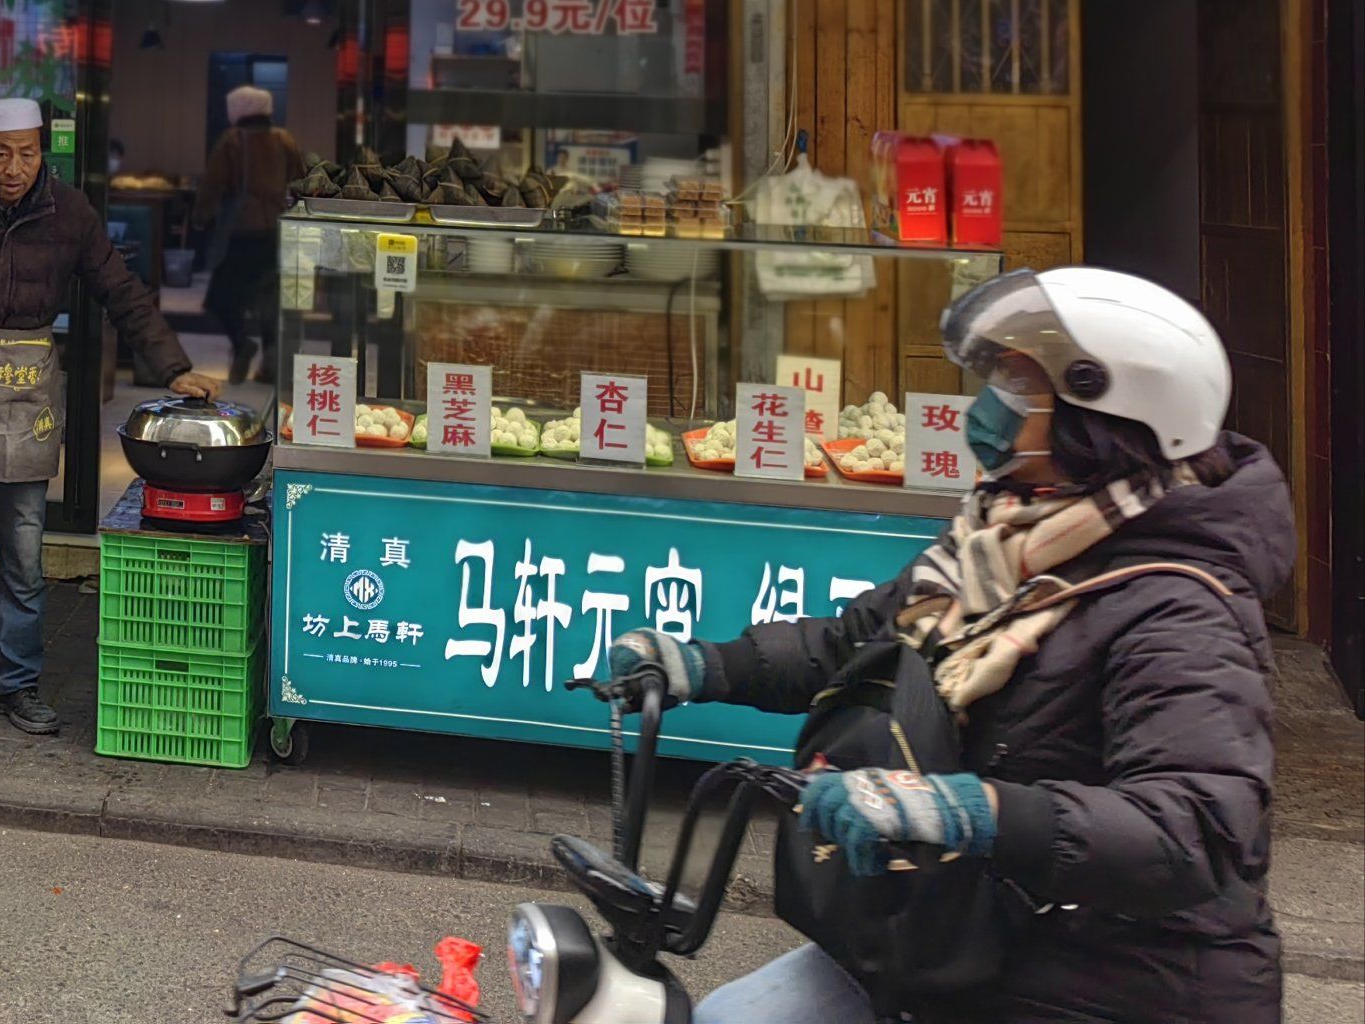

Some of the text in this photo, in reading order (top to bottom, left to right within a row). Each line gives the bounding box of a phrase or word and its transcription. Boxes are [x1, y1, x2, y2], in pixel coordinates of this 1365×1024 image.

[906, 187, 937, 204] 元宵
[307, 363, 341, 437] 核桃仁
[441, 372, 477, 447] 黑芝麻
[594, 380, 628, 450] 杏仁
[750, 393, 789, 469] 花生仁
[921, 404, 961, 479] 玫瑰
[320, 532, 411, 568] 清真
